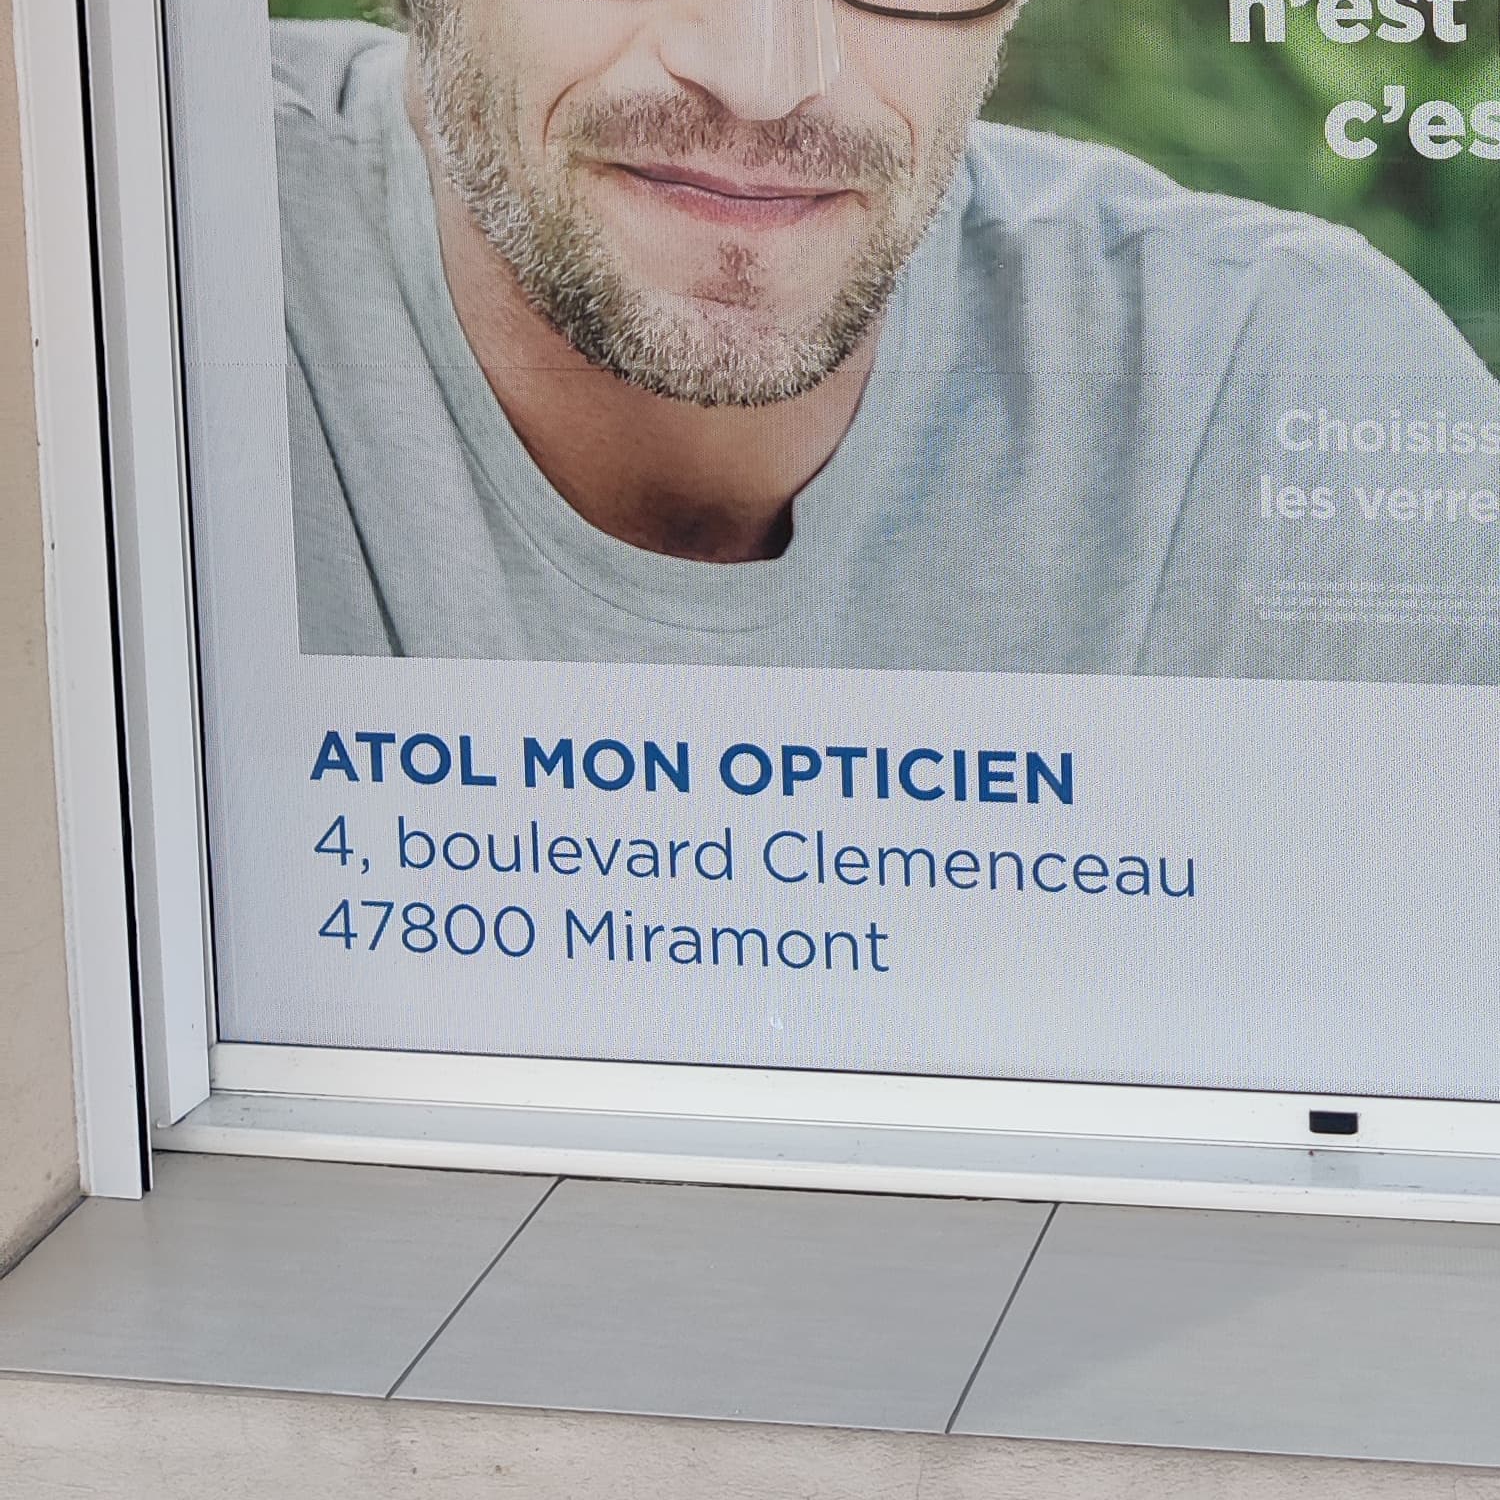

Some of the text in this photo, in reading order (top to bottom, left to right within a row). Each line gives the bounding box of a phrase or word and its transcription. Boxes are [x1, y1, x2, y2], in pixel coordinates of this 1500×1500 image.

[1260, 474, 1337, 520] les
[309, 729, 1075, 804] ATOL MON OPTICIEN
[313, 814, 1196, 898] 4, boulevard Clemenceau
[317, 899, 891, 973] 47800 Miramont
